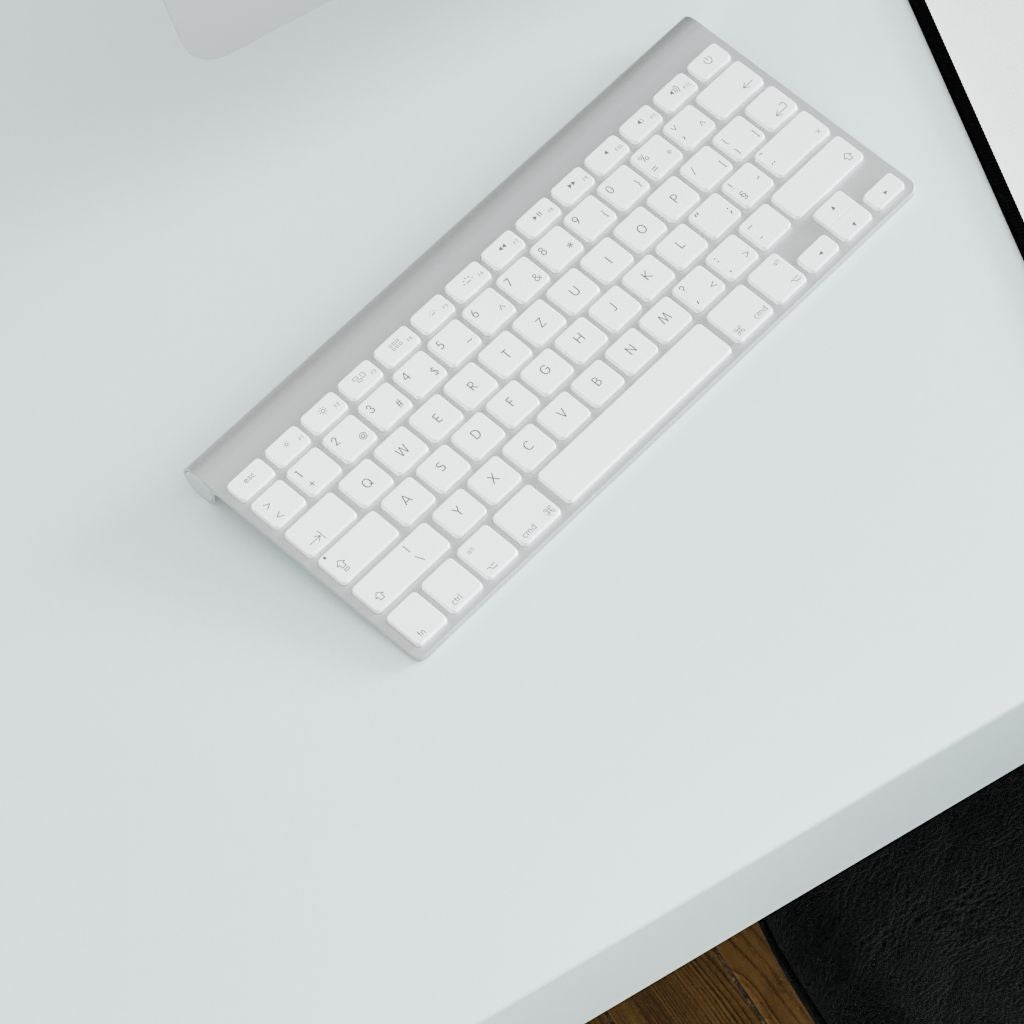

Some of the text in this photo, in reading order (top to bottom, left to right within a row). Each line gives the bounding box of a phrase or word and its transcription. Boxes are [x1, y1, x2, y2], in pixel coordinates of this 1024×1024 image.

[294, 470, 304, 478] 1
[330, 437, 342, 447] 2
[365, 405, 376, 414] 3
[402, 372, 411, 381] 4
[435, 340, 445, 350] 5
[470, 309, 480, 318] 6
[503, 278, 512, 287] 7
[537, 247, 548, 256] 8
[571, 216, 580, 225] 9
[605, 185, 615, 194] 0
[361, 478, 374, 488] Q
[394, 444, 409, 456] W
[432, 413, 443, 423] E
[466, 381, 478, 391] R
[500, 349, 511, 358] T
[535, 317, 547, 328] Z
[568, 285, 581, 296] U
[636, 224, 648, 234] O
[669, 194, 678, 203] P
[401, 496, 413, 506] A
[436, 462, 446, 471] S
[470, 430, 481, 440] D
[505, 397, 514, 407] F
[540, 364, 552, 376] G
[572, 332, 586, 344] H
[609, 302, 618, 311] J
[640, 270, 653, 280] K
[451, 505, 463, 515] Y
[487, 472, 501, 485] X
[521, 441, 534, 450] C
[556, 408, 567, 417] V
[591, 377, 602, 387] B
[624, 344, 637, 355] N
[658, 312, 672, 325] M
[522, 523, 538, 539] cmd
[754, 304, 769, 320] cmd
